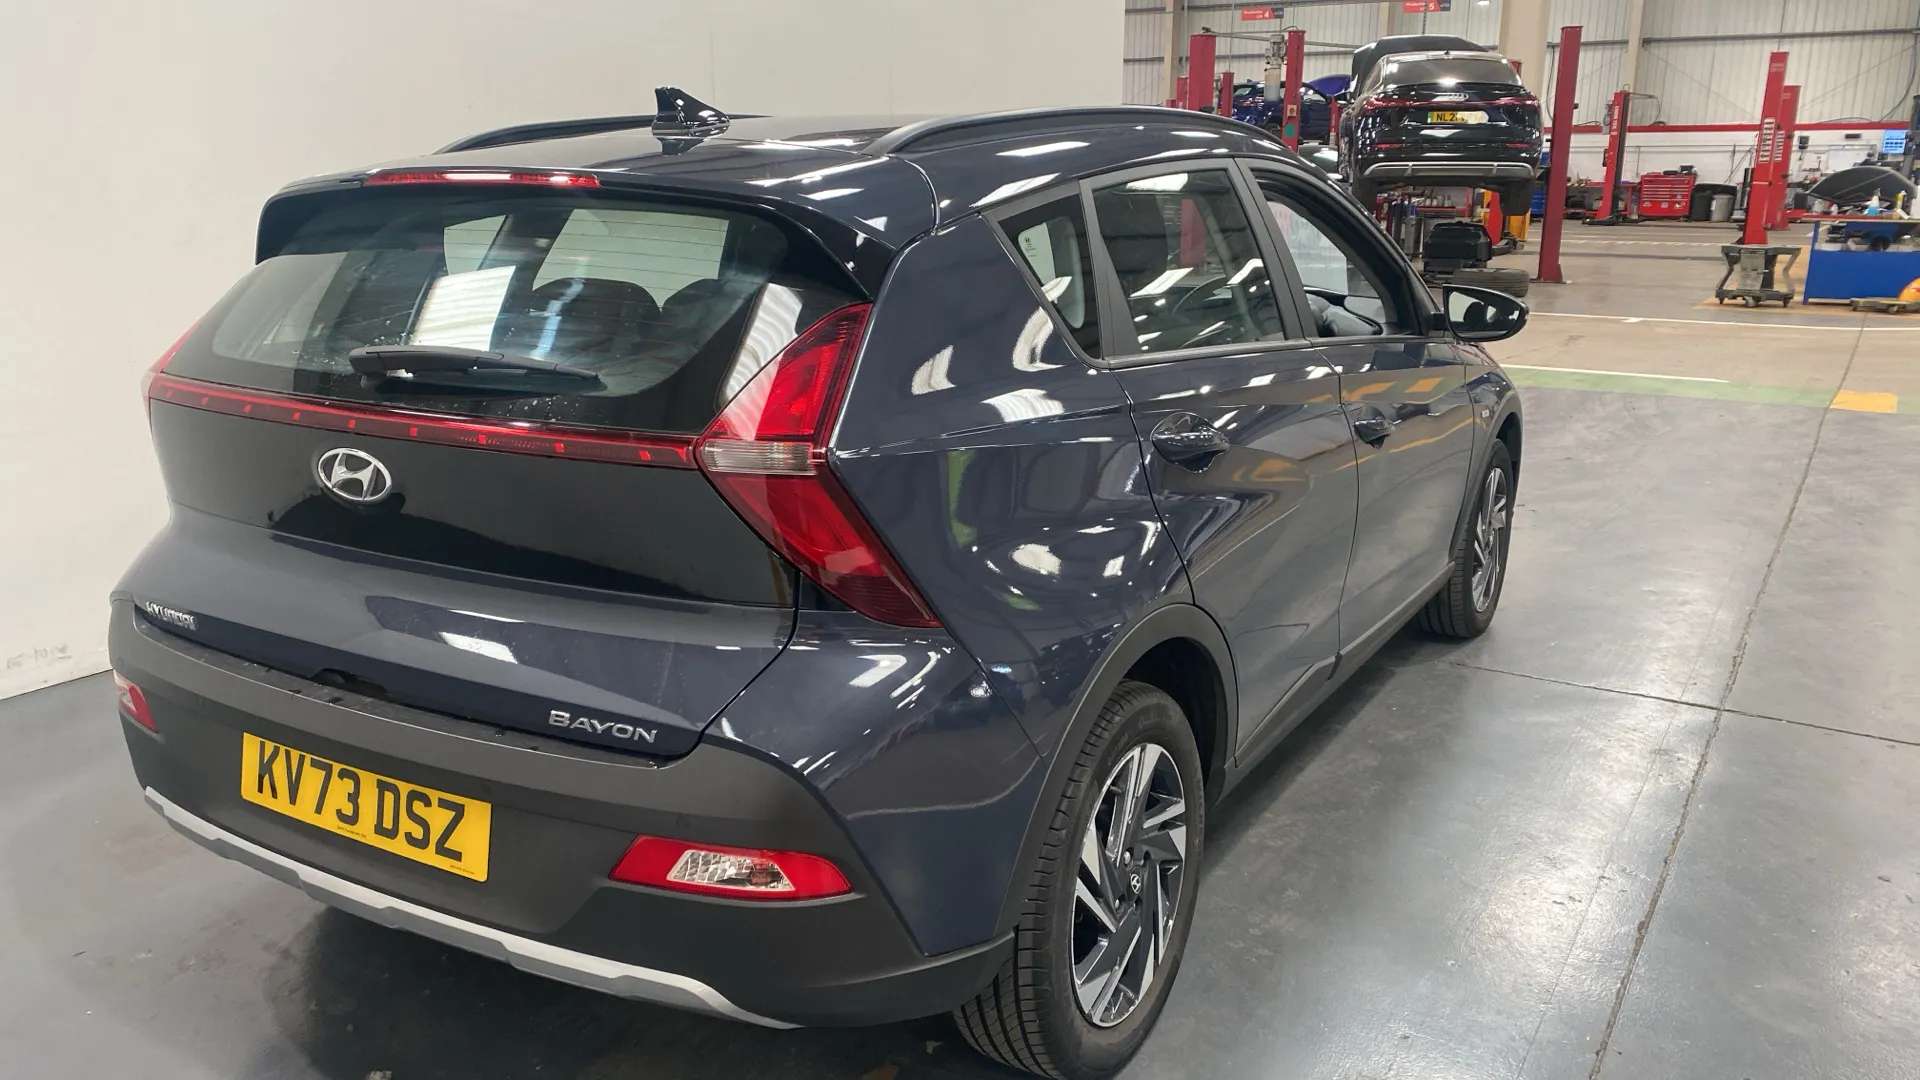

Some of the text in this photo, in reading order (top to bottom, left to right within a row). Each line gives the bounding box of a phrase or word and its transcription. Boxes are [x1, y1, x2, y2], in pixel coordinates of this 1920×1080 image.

[548, 709, 658, 743] BAYON
[257, 741, 466, 862] KV73 DSZ
